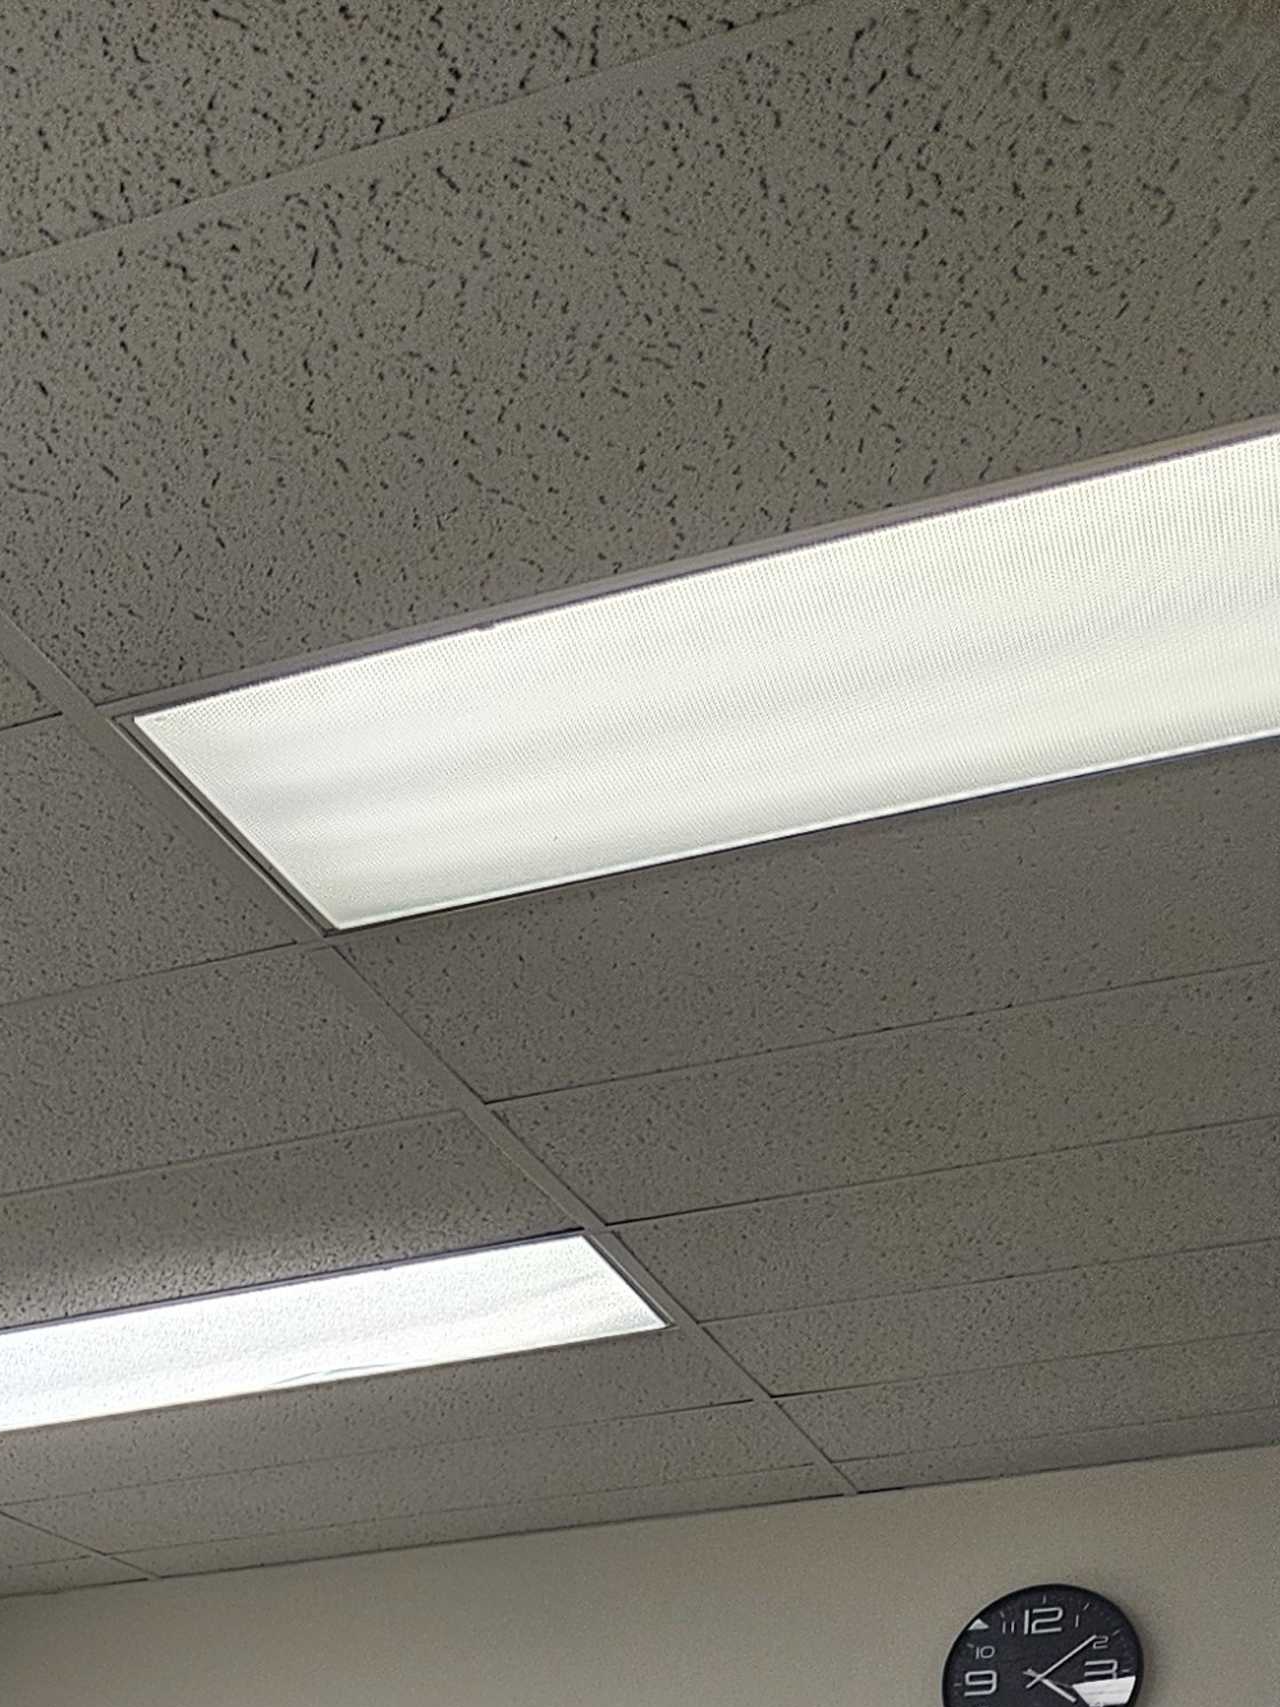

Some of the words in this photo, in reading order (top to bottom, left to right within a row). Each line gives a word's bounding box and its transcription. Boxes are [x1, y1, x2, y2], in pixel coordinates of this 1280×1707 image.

[1024, 1607, 1063, 1636] 12
[976, 1645, 995, 1660] 10
[1092, 1635, 1109, 1649] 2
[963, 1670, 998, 1697] 9
